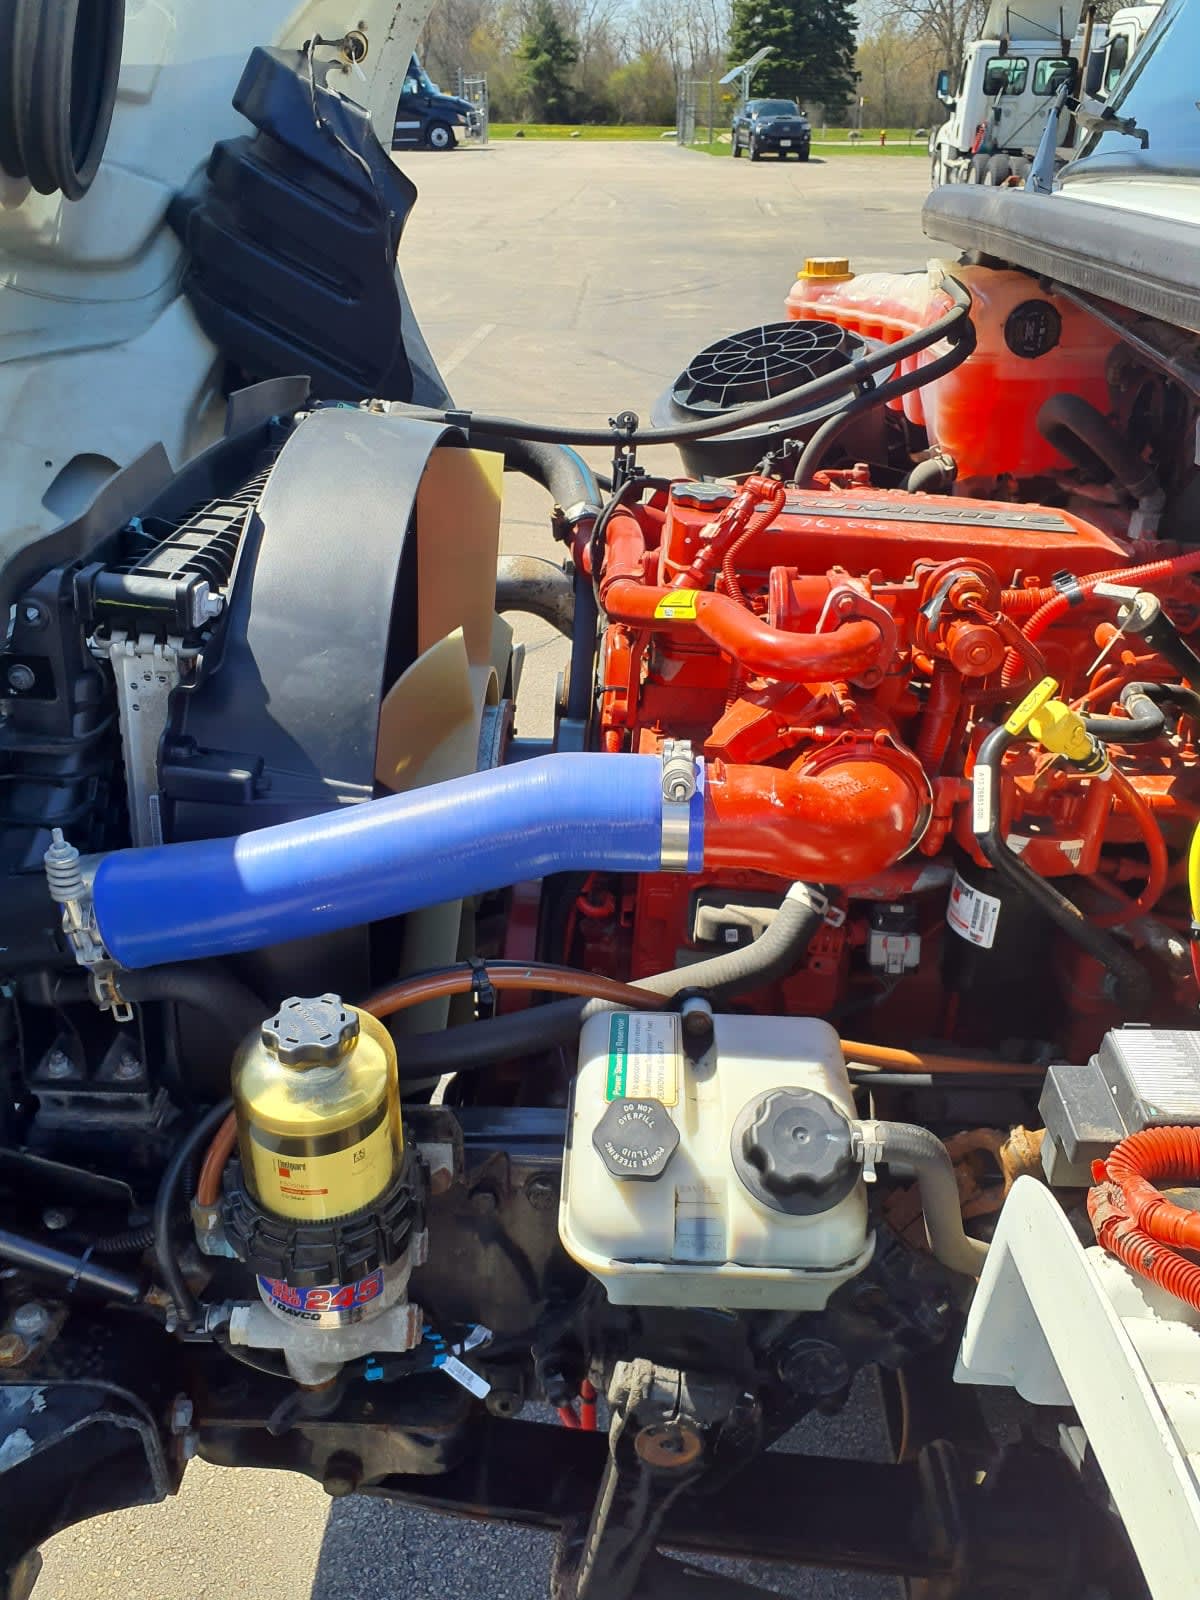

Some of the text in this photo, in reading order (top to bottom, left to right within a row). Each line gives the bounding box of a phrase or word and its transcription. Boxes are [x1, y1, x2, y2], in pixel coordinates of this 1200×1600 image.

[612, 1018, 625, 1096] Power Steering Reservoir
[623, 1103, 654, 1114] DO NOT
[618, 1112, 656, 1129] OVERFILL
[604, 1142, 665, 1168] POWER STEERING
[621, 1147, 649, 1159] FLUID
[304, 1274, 379, 1311] 245
[277, 1302, 322, 1321] DAVCO
